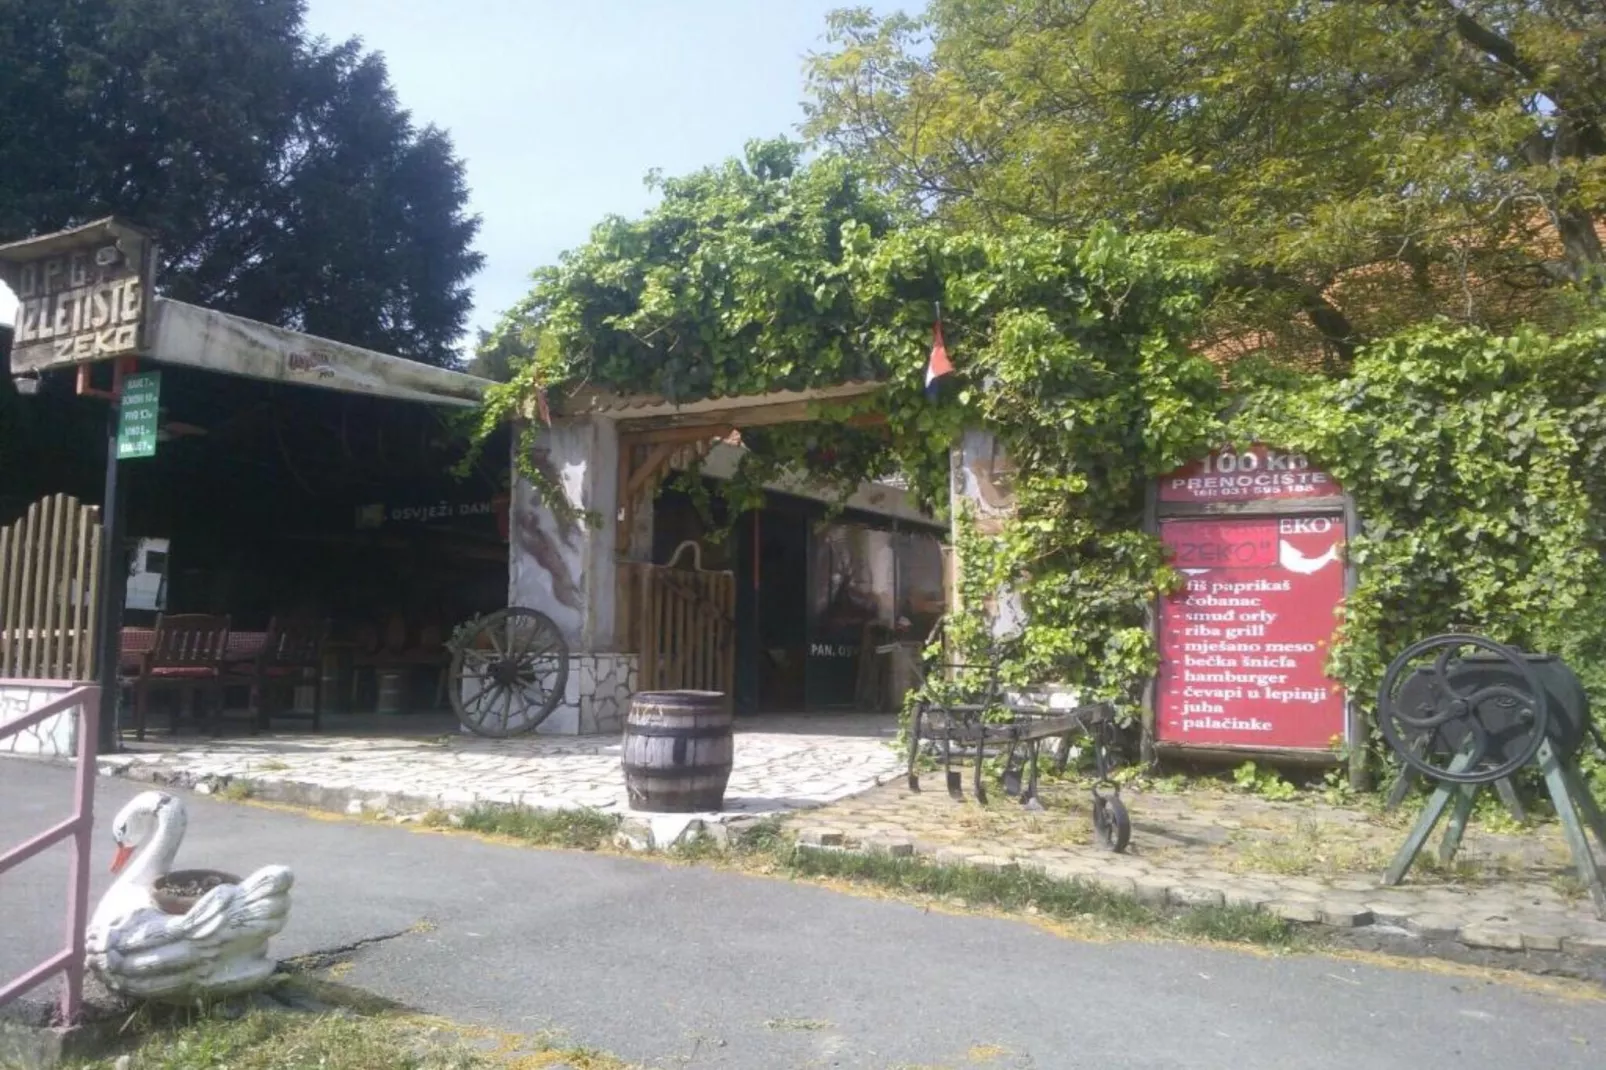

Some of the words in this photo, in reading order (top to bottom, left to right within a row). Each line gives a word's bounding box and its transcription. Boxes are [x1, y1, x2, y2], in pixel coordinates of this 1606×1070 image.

[53, 323, 138, 361] ZEKO
[1201, 451, 1258, 474] 100
[1212, 579, 1291, 594] paprikaš
[1186, 594, 1262, 606] čobanac
[1239, 610, 1278, 624] orly
[1184, 624, 1221, 636] riba
[1225, 624, 1265, 639] grill
[1184, 639, 1261, 654] mješano
[1265, 642, 1315, 652] meso
[1184, 655, 1238, 667] bečka
[1184, 669, 1288, 686] hamburger
[1183, 685, 1242, 701] čevapi
[1248, 690, 1260, 699] u
[1265, 686, 1327, 703] lepinji
[1181, 700, 1224, 715] juha
[1183, 716, 1273, 731] palačinke
